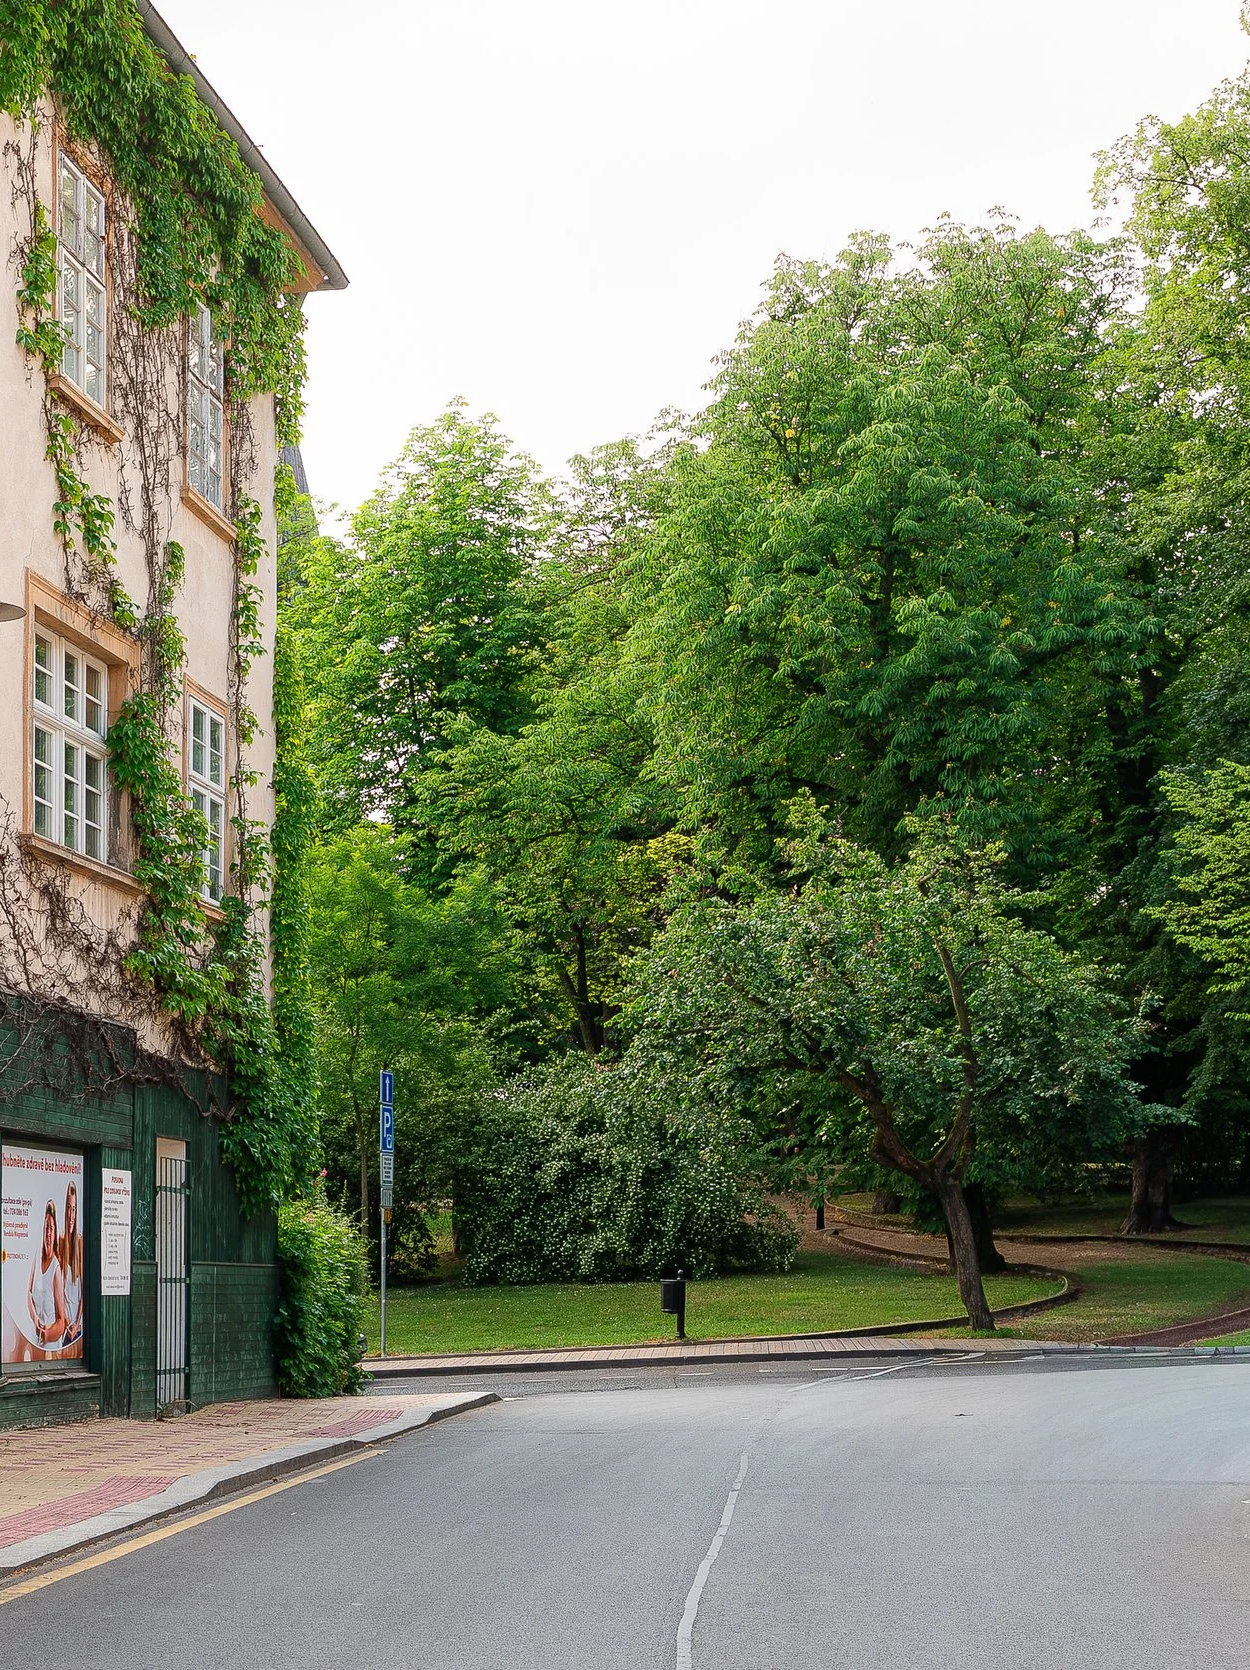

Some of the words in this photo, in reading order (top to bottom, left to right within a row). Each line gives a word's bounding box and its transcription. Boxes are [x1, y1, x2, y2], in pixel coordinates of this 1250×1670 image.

[383, 1111, 391, 1138] P
[1, 1152, 25, 1169] hubněte
[45, 1157, 54, 1172] bez
